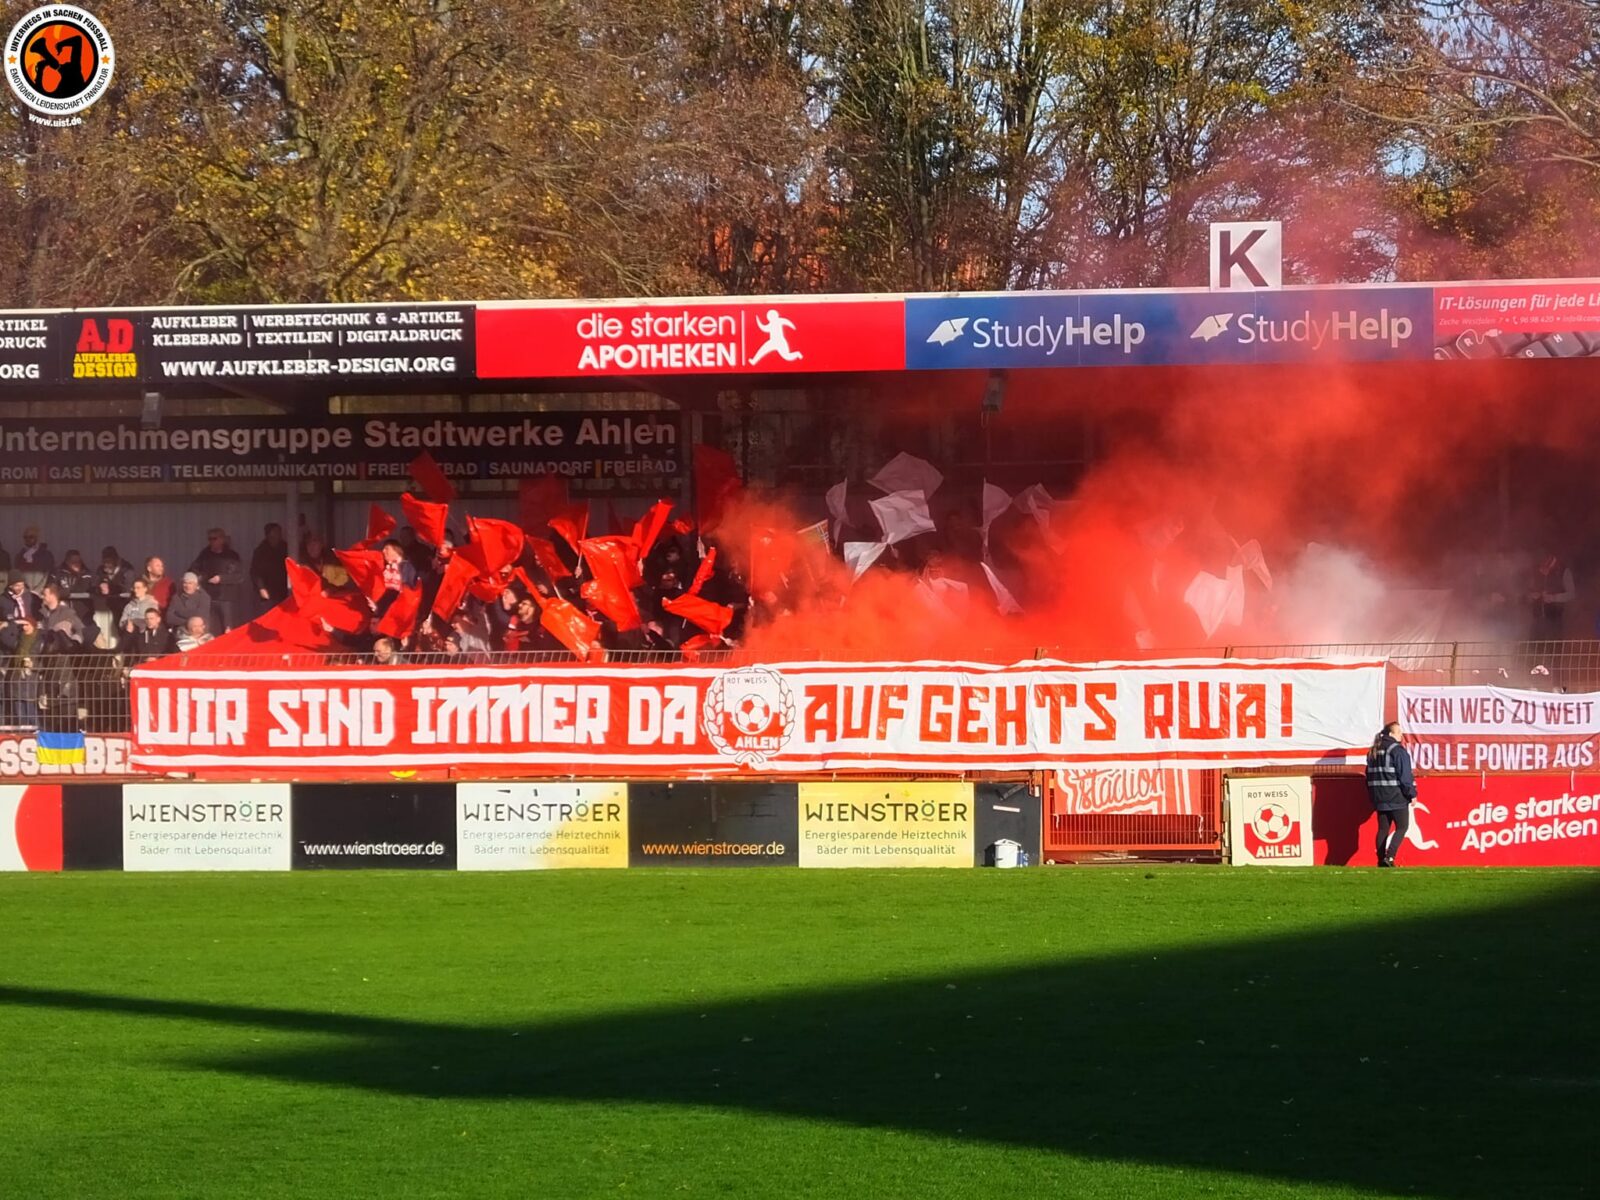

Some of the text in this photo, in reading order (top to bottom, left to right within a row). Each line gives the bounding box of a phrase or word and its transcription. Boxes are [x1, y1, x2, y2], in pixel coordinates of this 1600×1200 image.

[1219, 229, 1268, 289] K
[1439, 296, 1526, 312] IT-Lösungen
[1530, 294, 1552, 311] für
[1553, 293, 1585, 311] jede
[151, 311, 464, 329] AUFKLEBER WERBETECHNIK & -ARTIKEL
[577, 310, 736, 339] die starken
[76, 318, 134, 353] AD
[152, 328, 463, 346] KLEBEBAND TEXTILIEN DIGITALDRUCK
[973, 313, 1145, 355] StudyHelp
[1237, 308, 1413, 352] StudyHelp
[1553, 334, 1563, 343] H
[1464, 337, 1474, 347] R
[73, 353, 136, 362] AUFKLEBER
[577, 342, 737, 369] APOTHEKEN
[1525, 349, 1535, 358] G
[73, 362, 137, 378] DESIGN
[161, 356, 456, 376] WWW.AUFKLEBER-DESIGN.ORG
[0, 418, 676, 455] nternehmensgruppe Stadtwerke Ahlen
[50, 466, 82, 479] GAS
[93, 465, 161, 479] WASSER
[172, 463, 357, 478] TELEKOMMUNIKATION
[368, 462, 478, 476] FREIBAD
[488, 461, 592, 475] SAUNADORF
[744, 676, 768, 684] WEISS
[137, 684, 698, 747] WIR SIND IMMER DA
[804, 684, 908, 743] AUF
[1144, 681, 1293, 740] RWA!
[1406, 697, 1595, 725] KEIN WEG ZU WEIT
[735, 736, 779, 749] AHLEN
[1406, 741, 1594, 770] VOLLE POWER AUS
[1264, 790, 1289, 798] WEISS
[129, 800, 284, 823] WIENSTRÖER
[464, 800, 620, 822] WIENSTRÖER
[805, 800, 967, 822] WIENSTRÖER
[1446, 802, 1509, 829] ...die
[129, 830, 283, 841] Energiesparende Heiztechnik
[463, 829, 621, 841] Energiesparende Heiztechnik
[805, 830, 967, 841] Energiesparende Heiztechnik
[1461, 818, 1598, 853] Apotheken
[174, 845, 191, 855] mit
[304, 840, 444, 856] www.wienstroeer.de
[509, 845, 526, 855] mit
[642, 840, 785, 856] www.wienstroeer.de
[852, 845, 871, 855] mit
[874, 845, 956, 857] Lebensqualität
[1256, 844, 1301, 858] AHLEN
